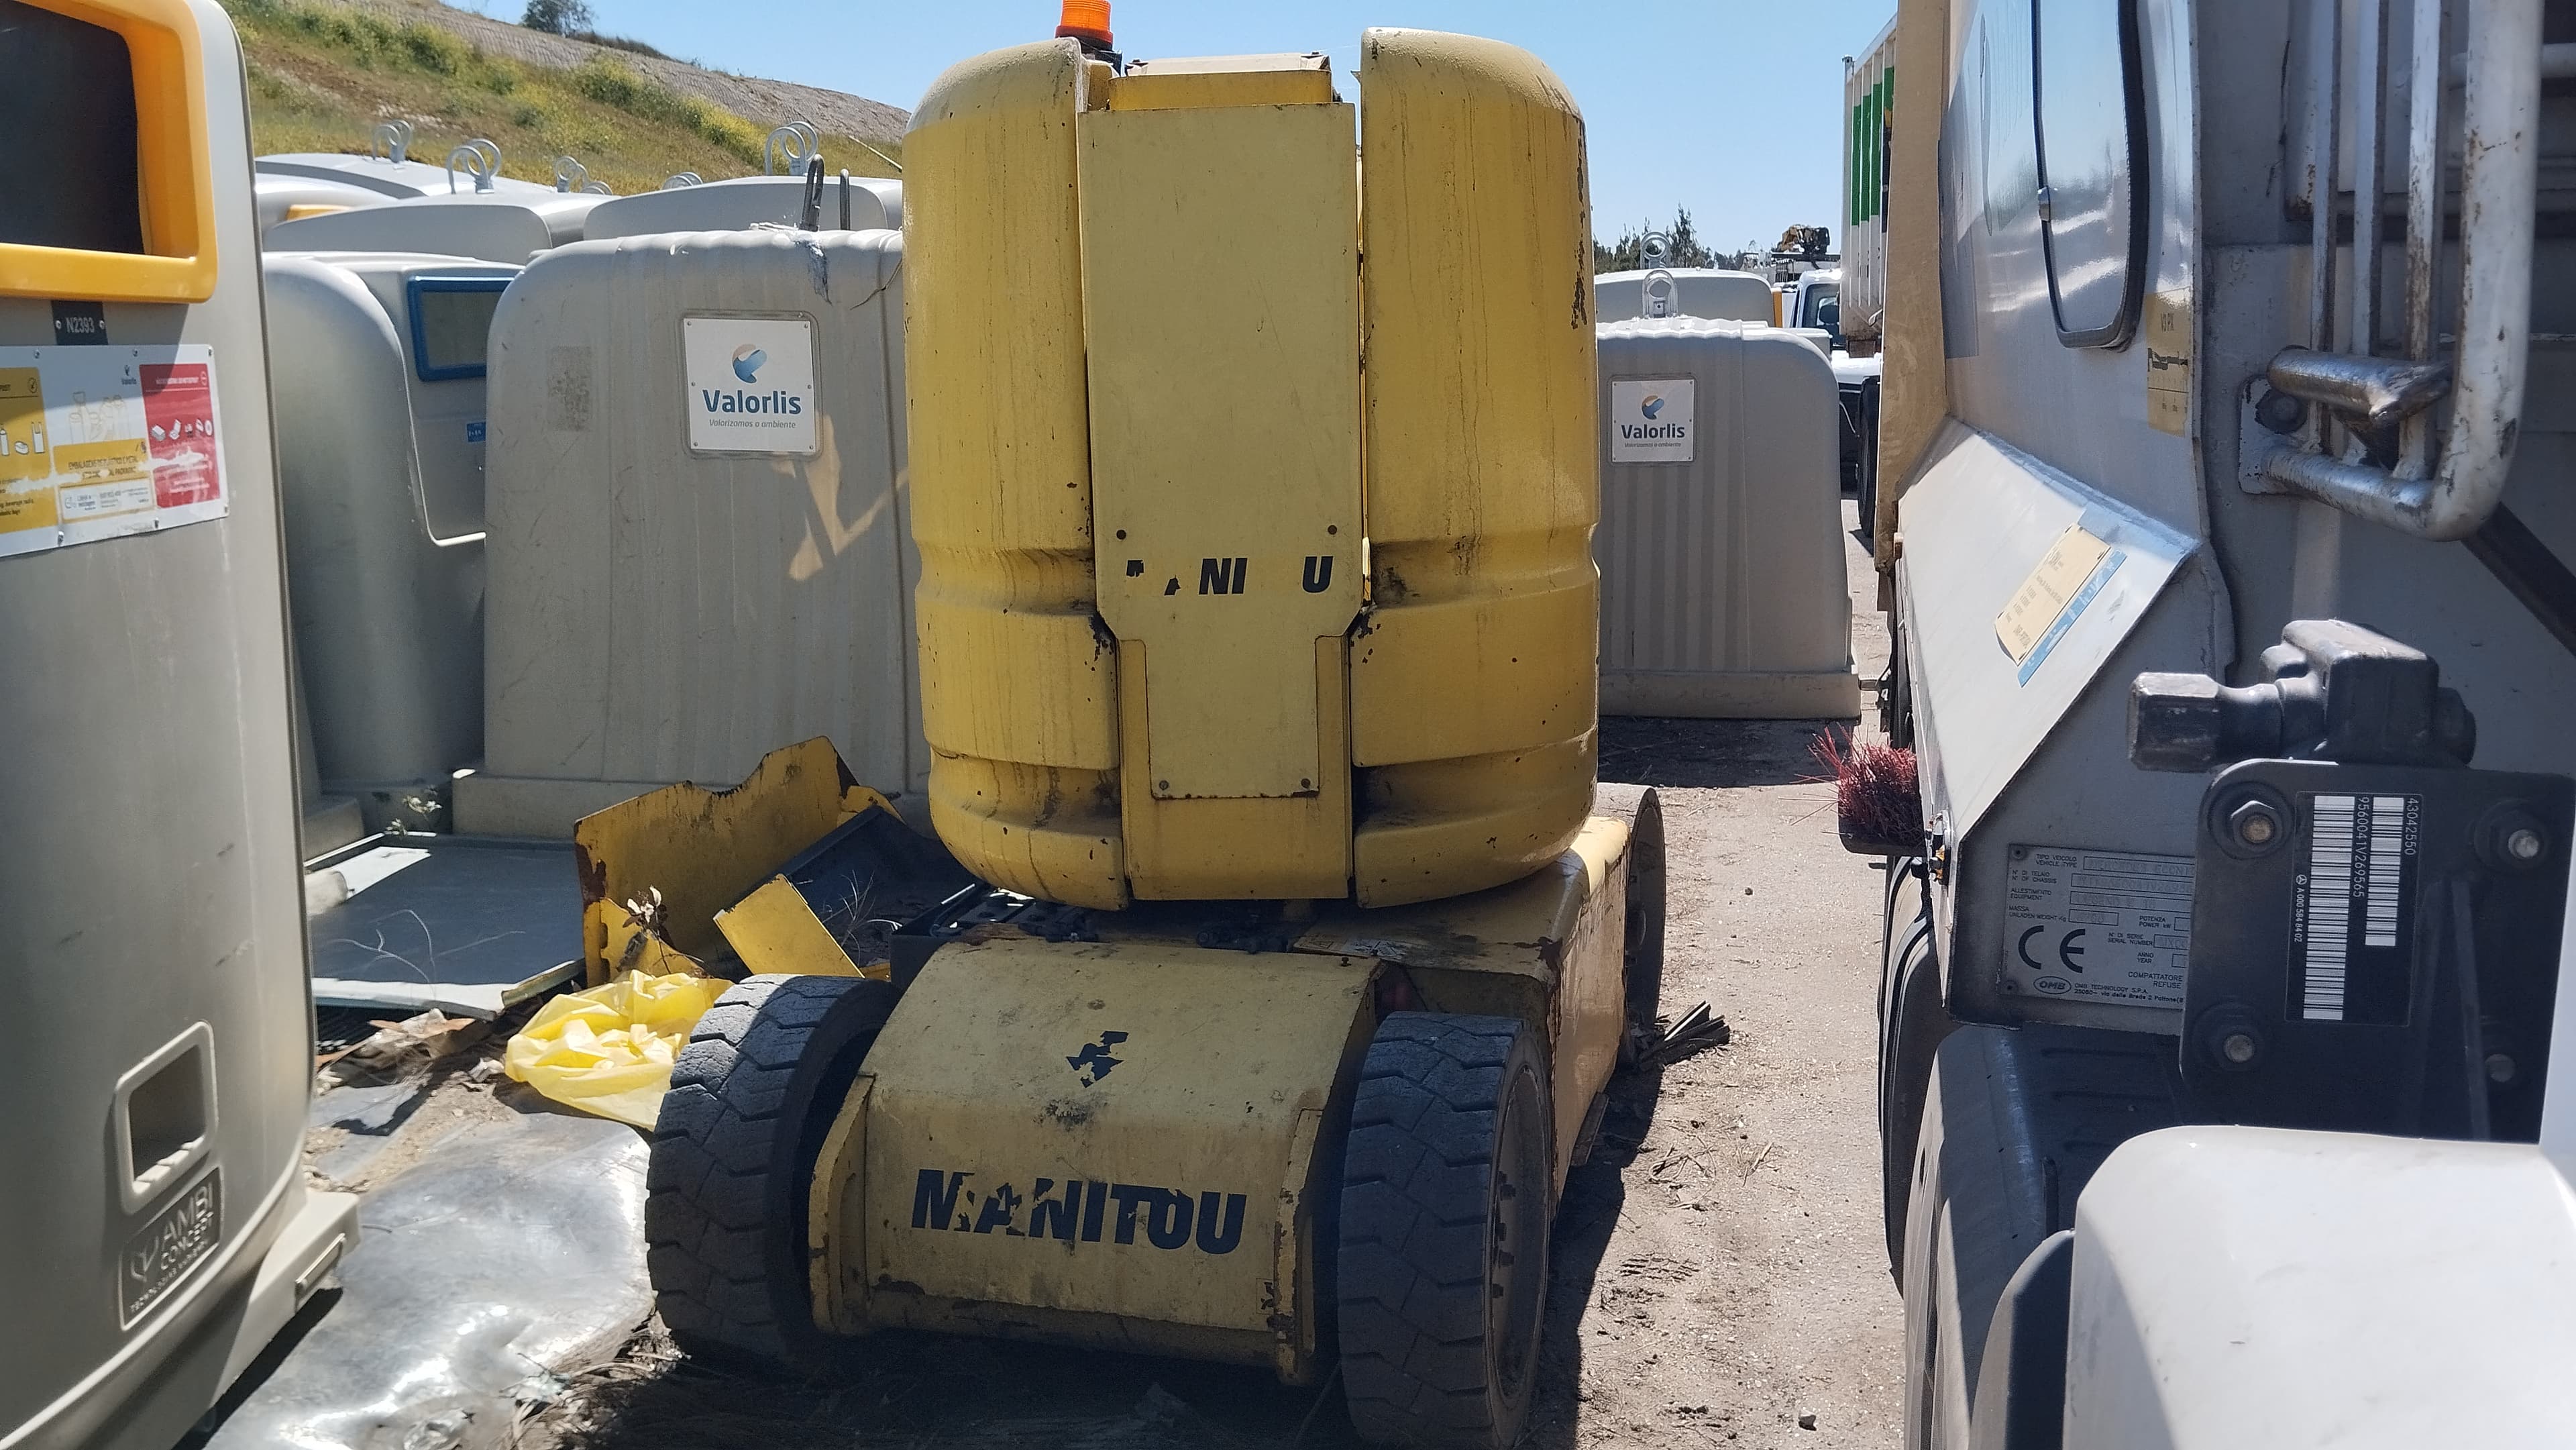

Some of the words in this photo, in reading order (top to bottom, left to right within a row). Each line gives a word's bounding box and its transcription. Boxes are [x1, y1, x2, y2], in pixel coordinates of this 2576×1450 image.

[66, 316, 95, 333] N2393
[702, 389, 802, 415] Valorlis
[709, 419, 753, 427] Valorizamos
[761, 421, 796, 429] ambiente
[1621, 423, 1685, 439] Valorlis
[2404, 797, 2419, 856] 43042550
[2353, 796, 2369, 898] 9560041V269565
[2011, 888, 2052, 896] ALLESTIMENTO
[2296, 894, 2304, 908] 000
[2296, 909, 2304, 922] 584
[2128, 971, 2184, 982] COMPATTATORE
[2039, 980, 2065, 990] OMB
[2091, 984, 2129, 992] TECHNOLOGY
[2153, 981, 2182, 989] REFUSE
[911, 1169, 1247, 1254] MANITOU
